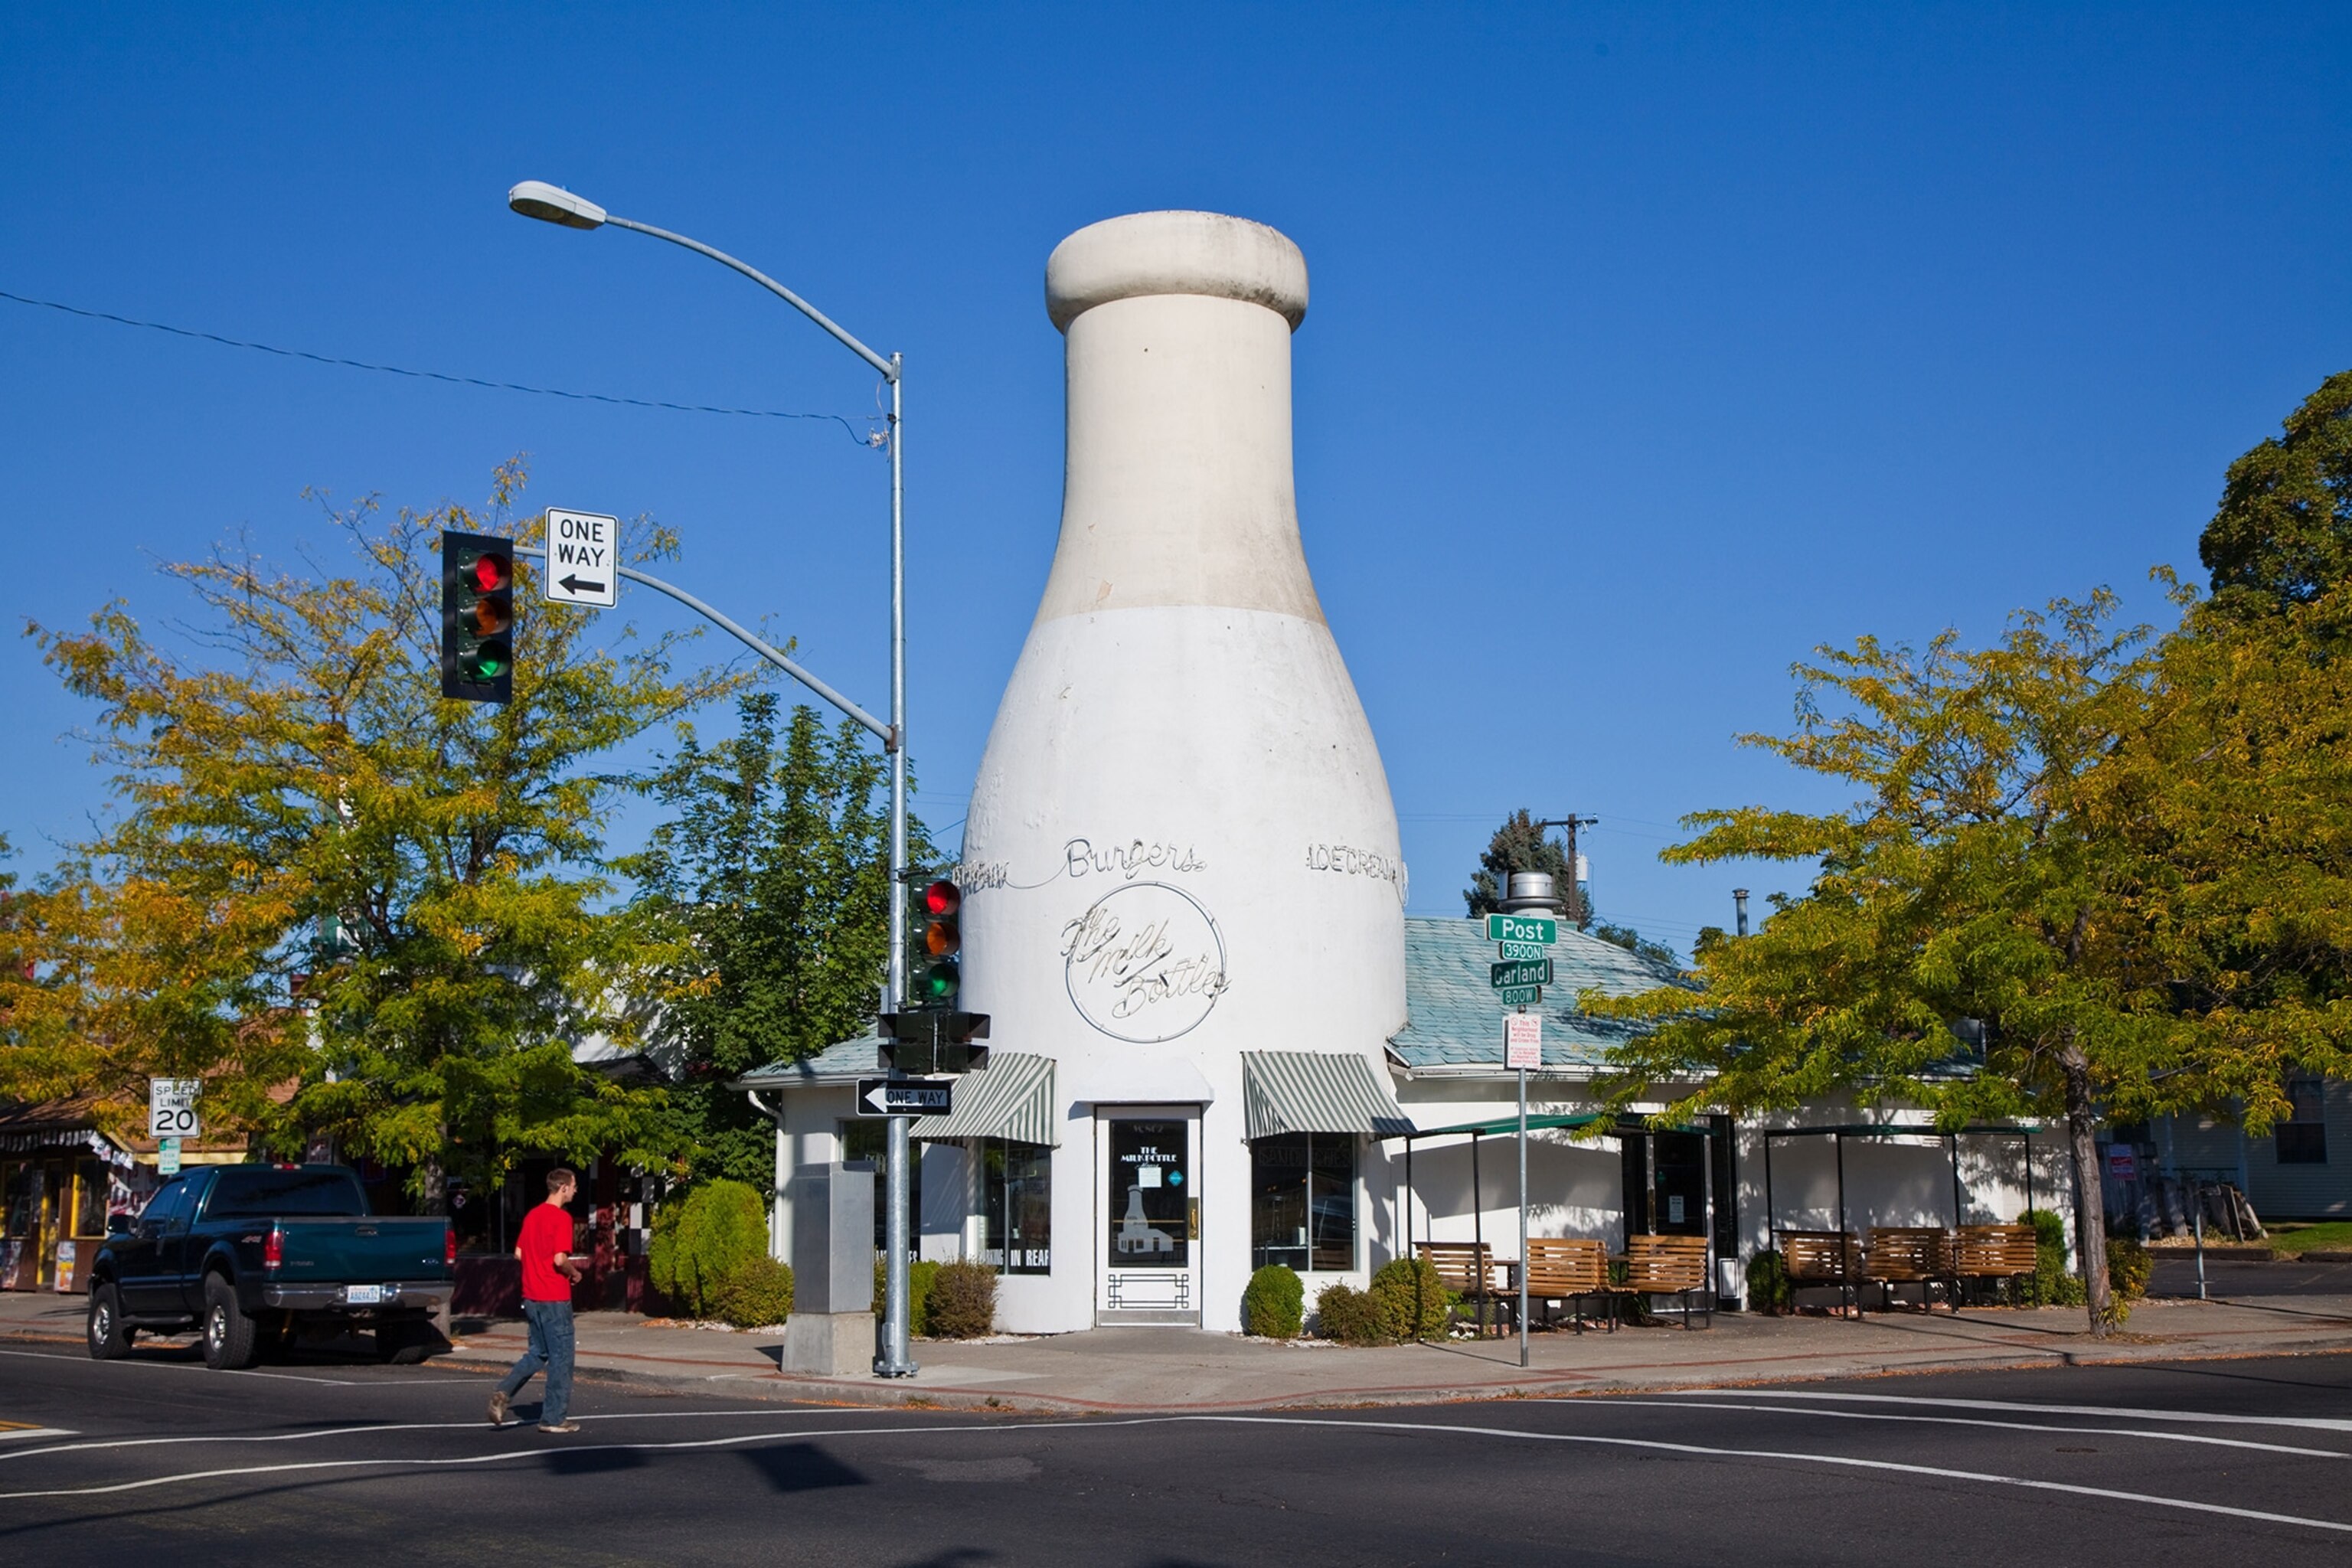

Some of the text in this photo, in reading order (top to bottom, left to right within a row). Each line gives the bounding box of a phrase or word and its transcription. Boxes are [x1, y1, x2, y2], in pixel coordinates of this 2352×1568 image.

[560, 518, 604, 543] ONE
[558, 543, 605, 567] WAY
[1064, 838, 1207, 880] Burgers
[1060, 904, 1121, 964] The
[1502, 918, 1544, 940] Post
[1088, 918, 1174, 987] Milk
[1506, 943, 1541, 959] 3900N
[1494, 962, 1545, 985] Garland
[1112, 953, 1232, 1019] Bottle
[1505, 988, 1534, 1004] 800W
[887, 1090, 944, 1105] ONE WAY
[156, 1109, 194, 1131] 20
[1140, 1145, 1158, 1155] THE
[1011, 1249, 1021, 1266] IN
